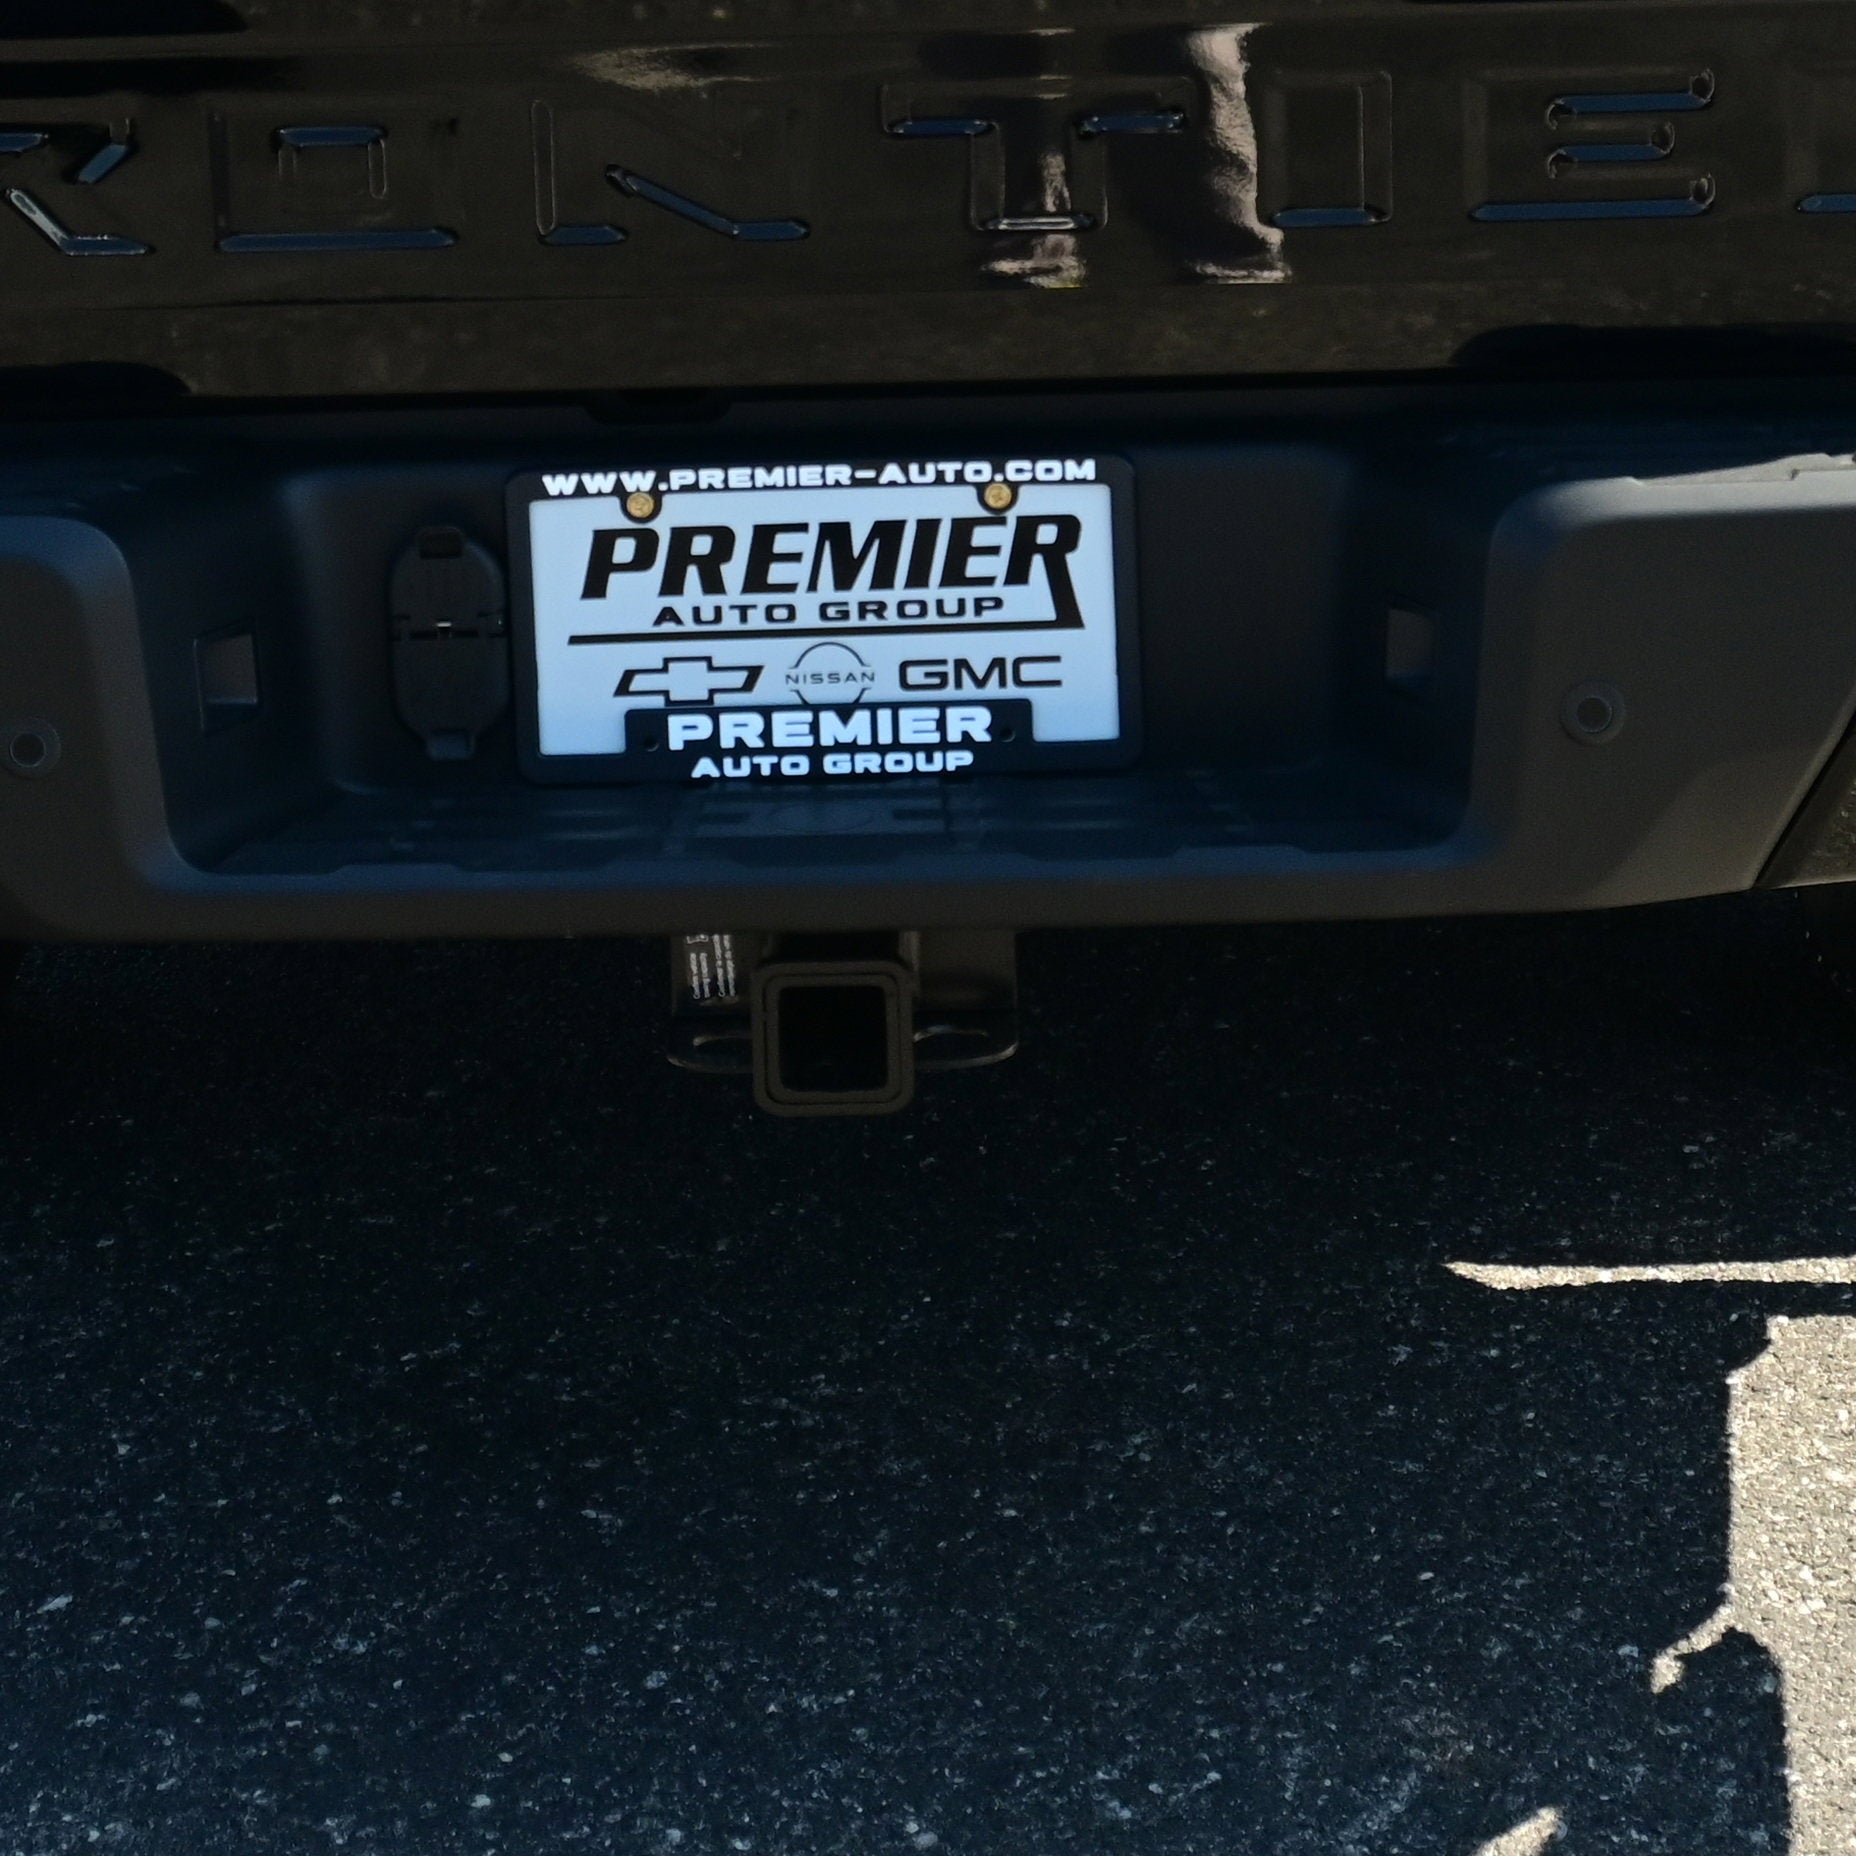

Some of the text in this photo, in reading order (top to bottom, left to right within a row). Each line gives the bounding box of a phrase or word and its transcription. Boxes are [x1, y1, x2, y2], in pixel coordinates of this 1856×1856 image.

[542, 459, 1097, 497] WWW.PREMIER-AUTO.COM
[580, 514, 1085, 629] PREMIER
[652, 596, 1006, 628] AUTO GROUP
[784, 665, 877, 687] NISSAN
[898, 655, 1064, 692] GMC
[667, 706, 992, 751] PREMIER
[690, 750, 975, 779] AUTO GROUP
